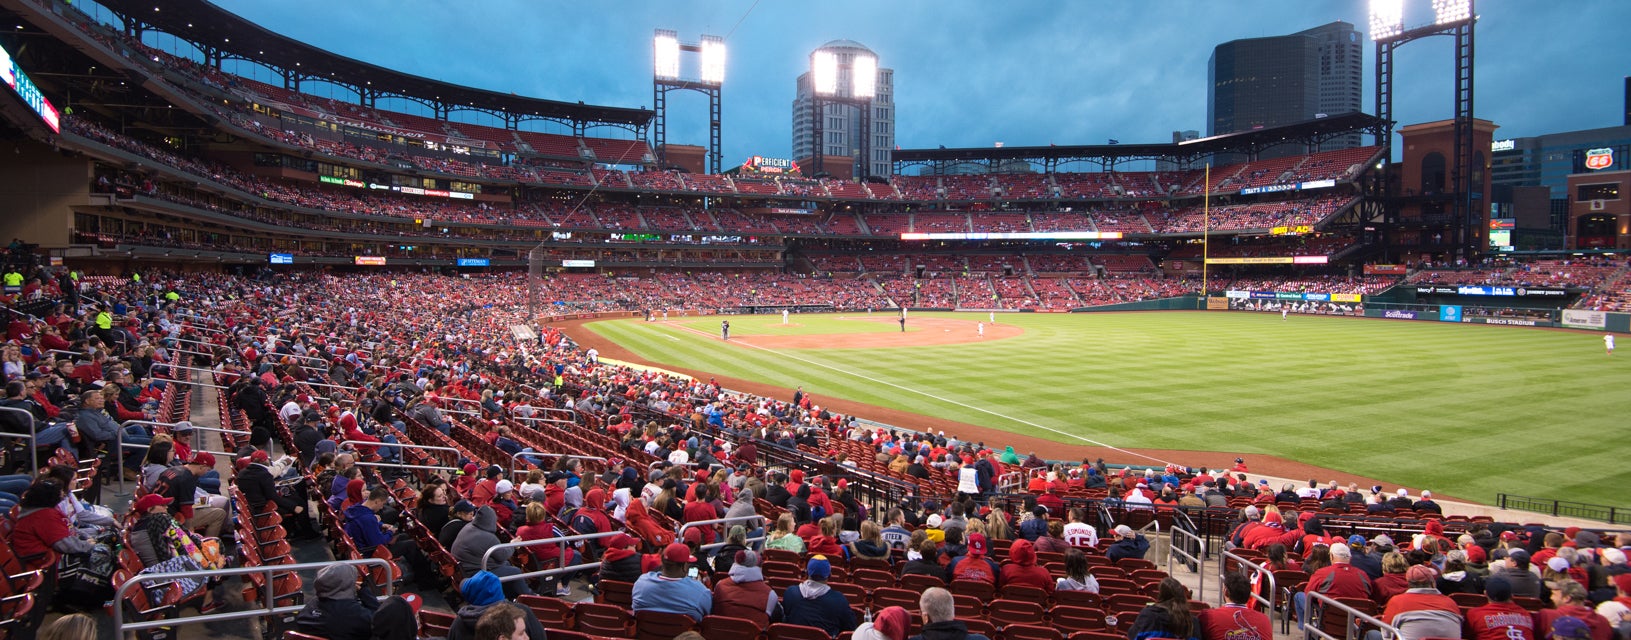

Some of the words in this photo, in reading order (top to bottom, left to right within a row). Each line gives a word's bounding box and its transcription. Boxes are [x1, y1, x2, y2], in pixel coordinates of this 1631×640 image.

[328, 113, 425, 138] Budweiser
[753, 155, 789, 167] PERFICIENT
[1590, 155, 1609, 167] 66
[1273, 226, 1288, 235] BIG
[1385, 310, 1414, 320] Scottrade
[1067, 528, 1093, 536] EDMONDS
[1070, 536, 1090, 547] 15
[1484, 612, 1533, 630] CARDINALS
